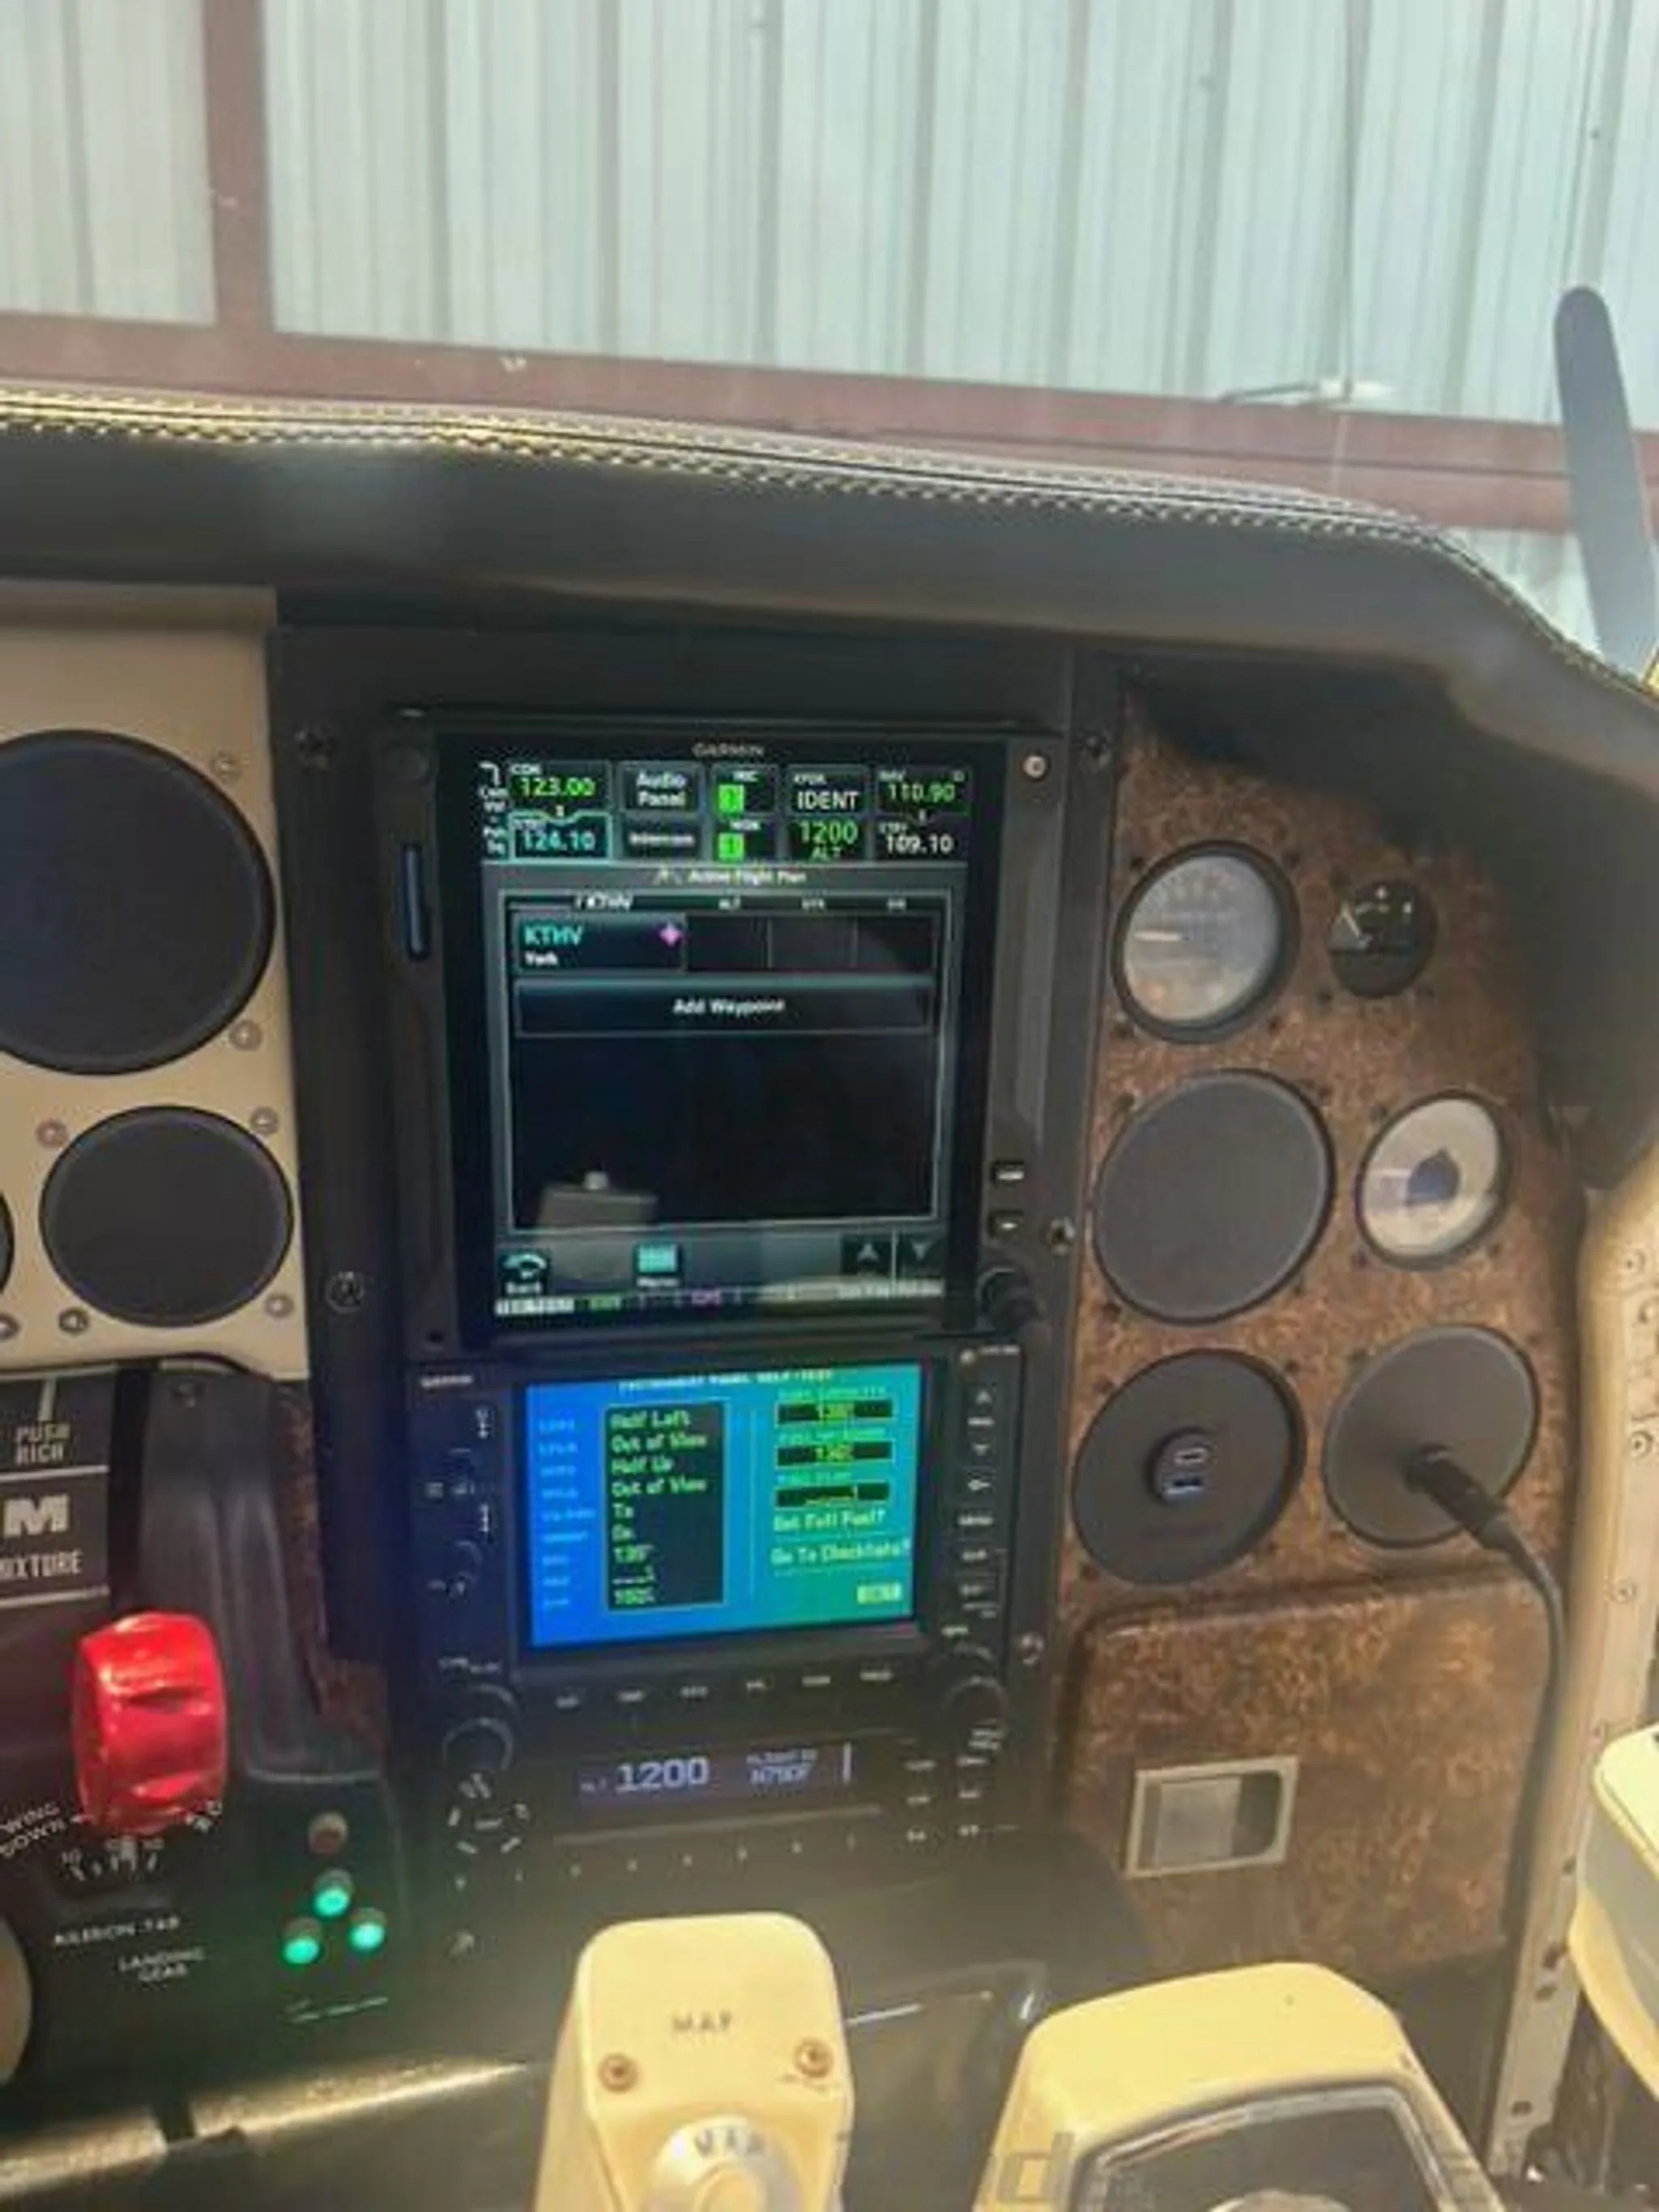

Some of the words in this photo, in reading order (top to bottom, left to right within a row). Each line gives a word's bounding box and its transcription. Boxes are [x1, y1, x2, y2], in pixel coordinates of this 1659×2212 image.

[518, 777, 596, 797] 123.00
[797, 791, 859, 811] IDENT
[798, 820, 859, 844] 1200
[525, 926, 582, 944] KTHV
[3, 1494, 69, 1536] M
[616, 1756, 710, 1792] 1200
